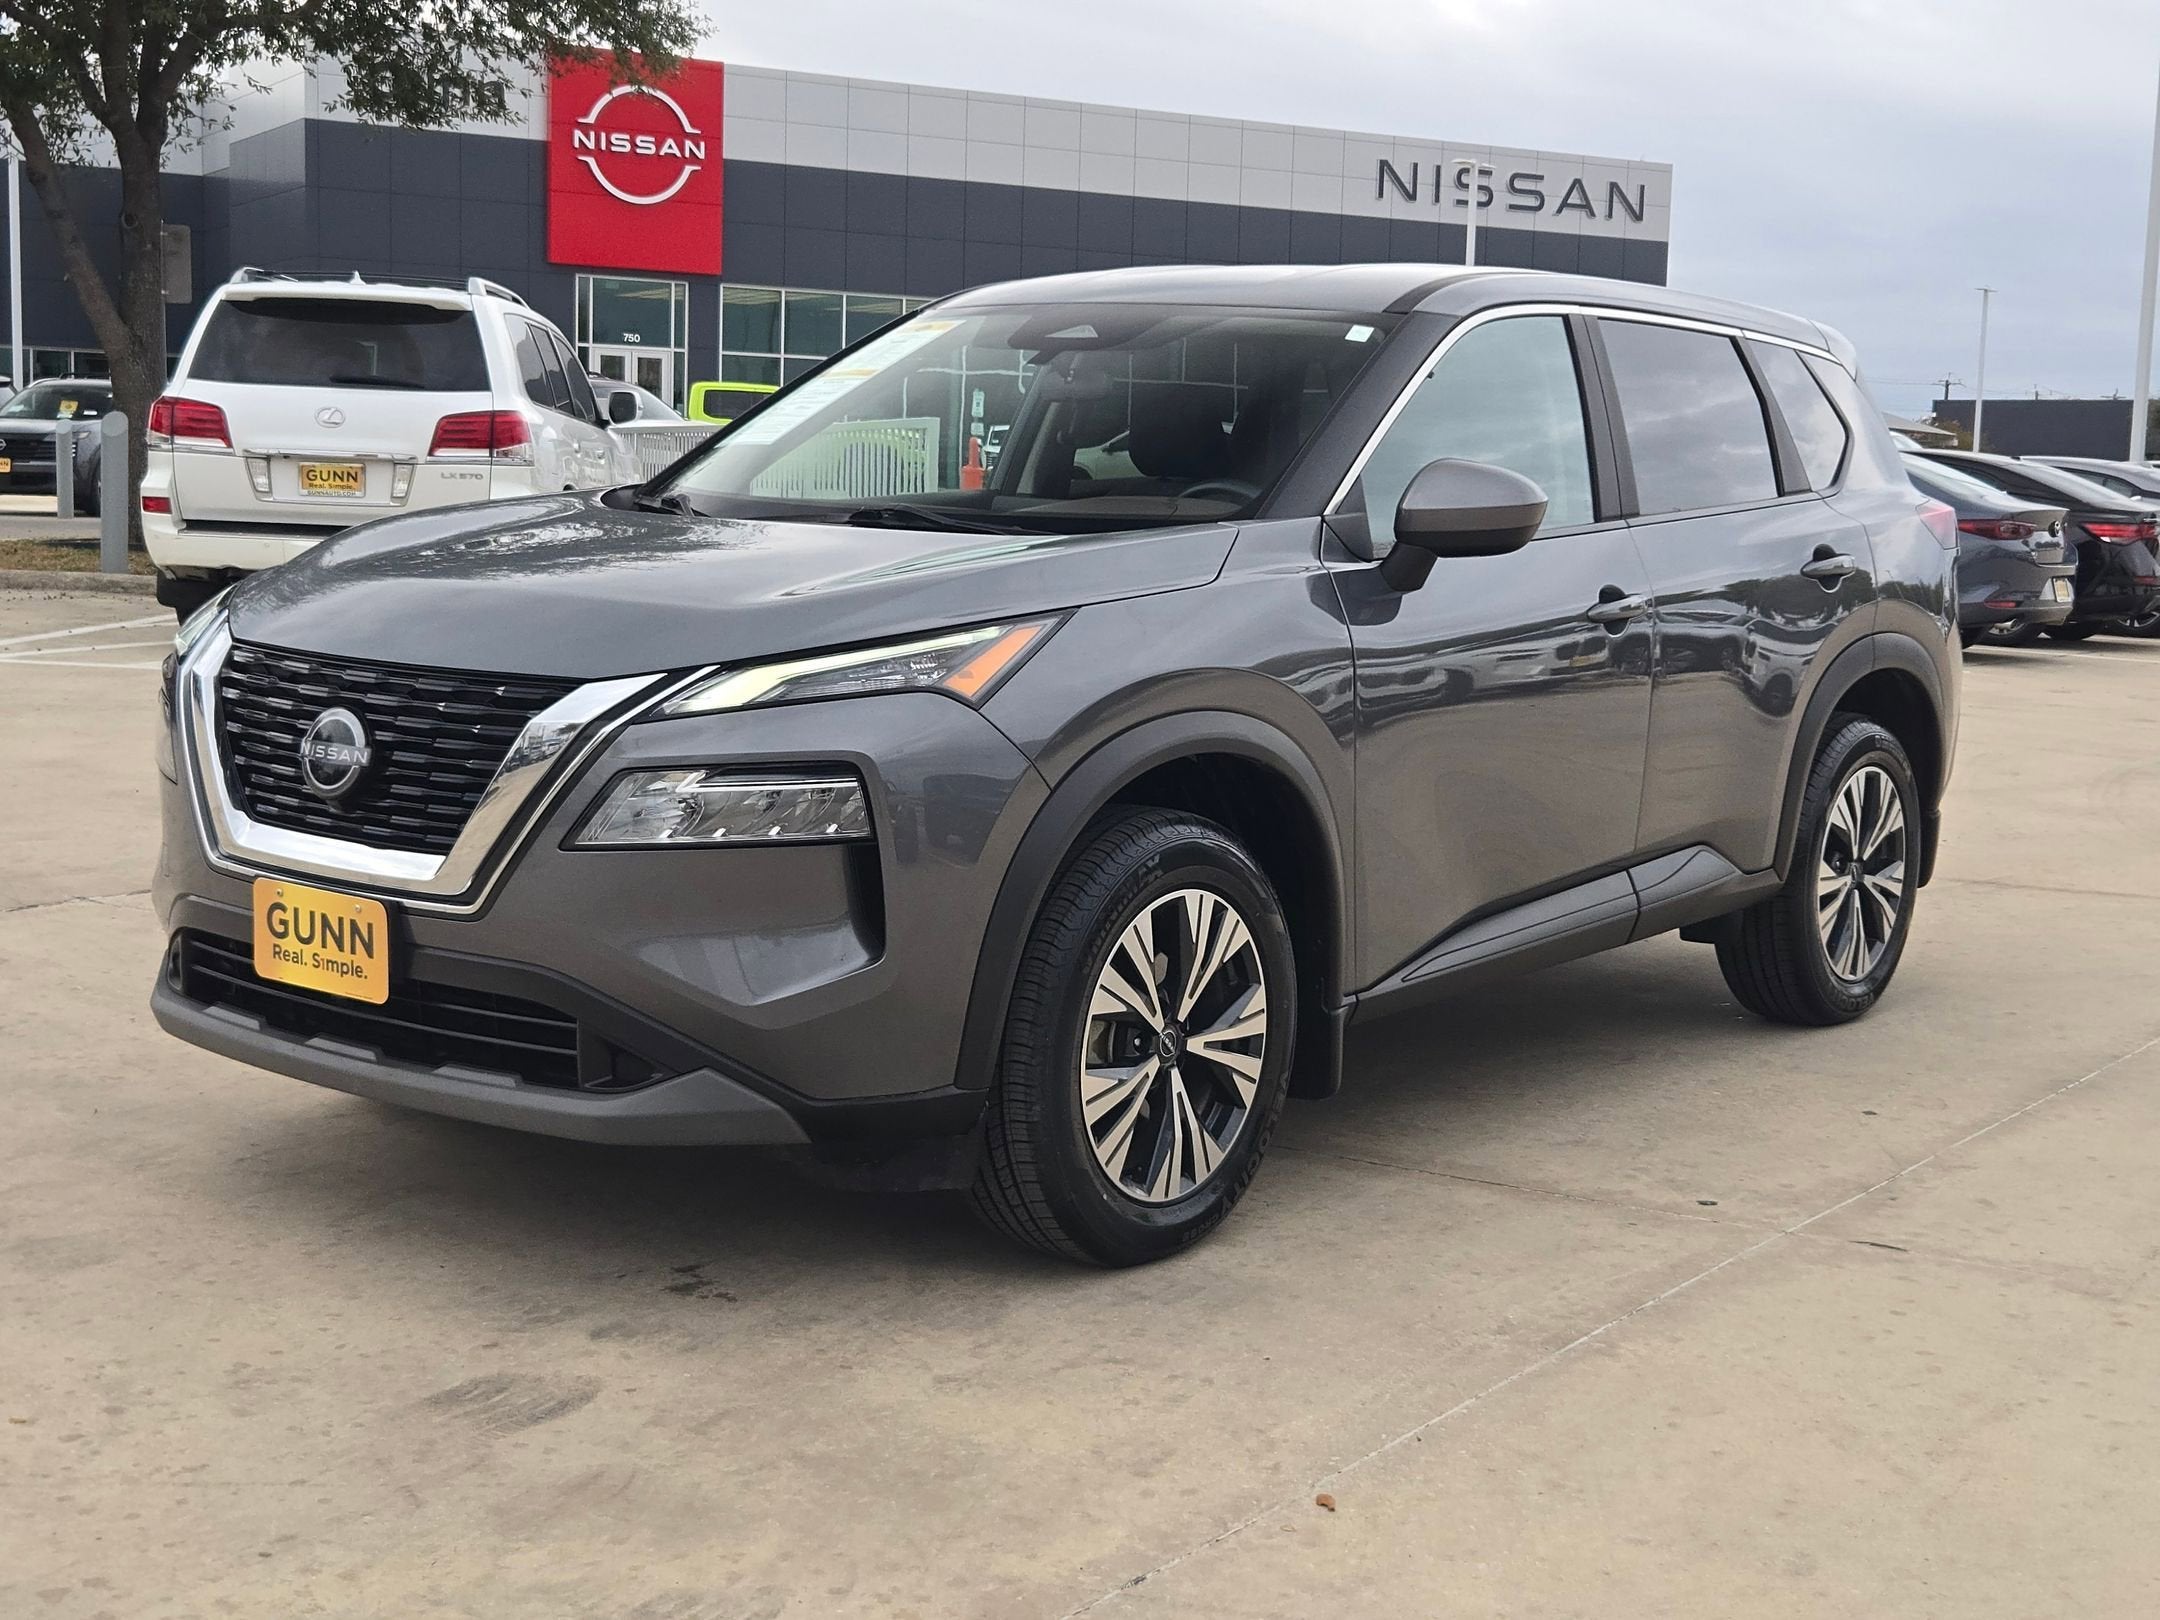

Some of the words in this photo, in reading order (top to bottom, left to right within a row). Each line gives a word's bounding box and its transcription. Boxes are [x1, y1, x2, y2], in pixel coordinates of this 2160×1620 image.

[573, 129, 706, 160] NISSAN
[1376, 159, 1646, 223] NISSAN
[623, 333, 641, 343] 750
[306, 469, 358, 483] GUNN
[301, 739, 368, 764] NISSAN
[266, 901, 375, 960] GUNN
[272, 943, 308, 967] Real.
